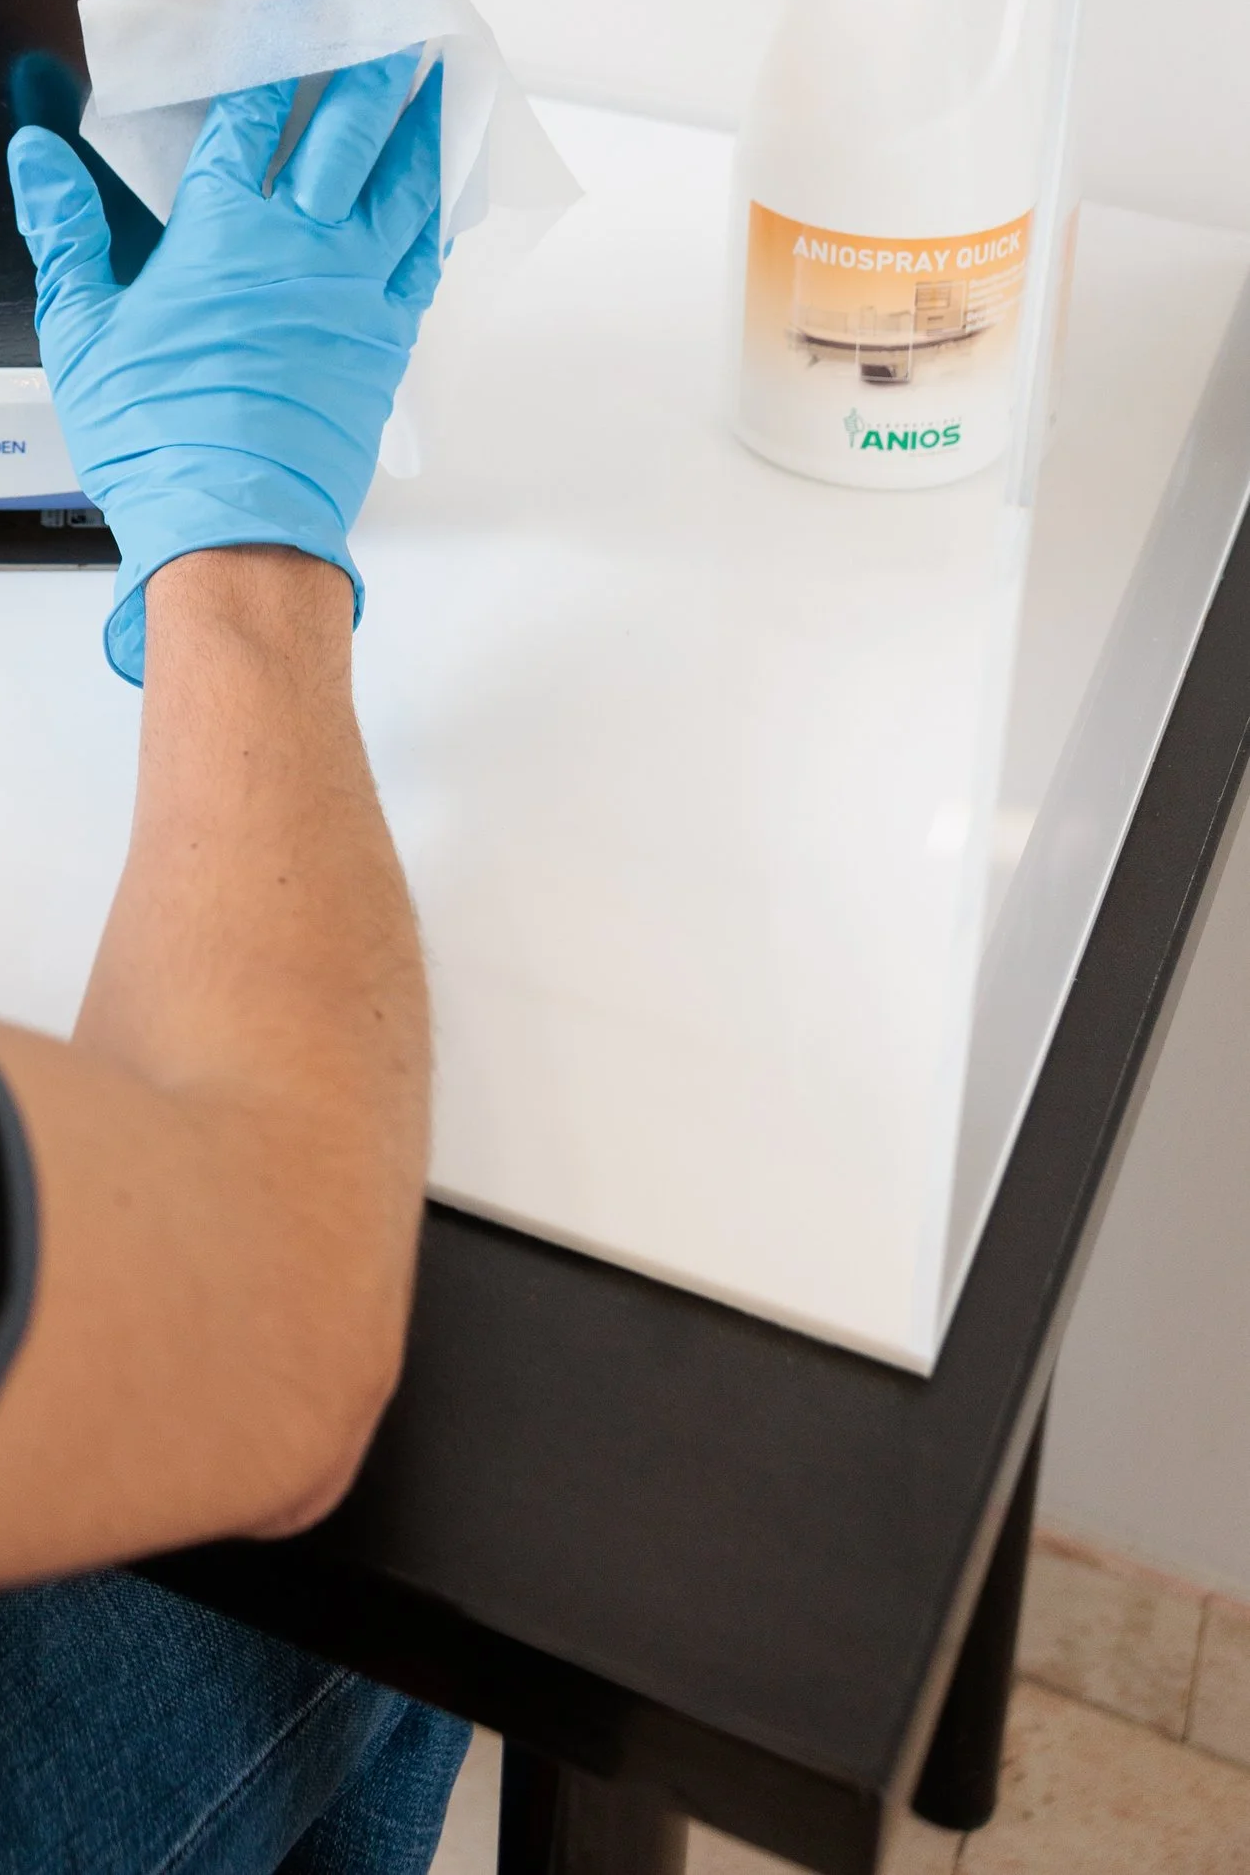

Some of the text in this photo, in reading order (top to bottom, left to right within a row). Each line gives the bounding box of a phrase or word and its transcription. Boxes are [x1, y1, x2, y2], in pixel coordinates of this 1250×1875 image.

[792, 229, 1022, 273] ANIOSPRAY QUICK
[861, 423, 961, 451] ANIOS
